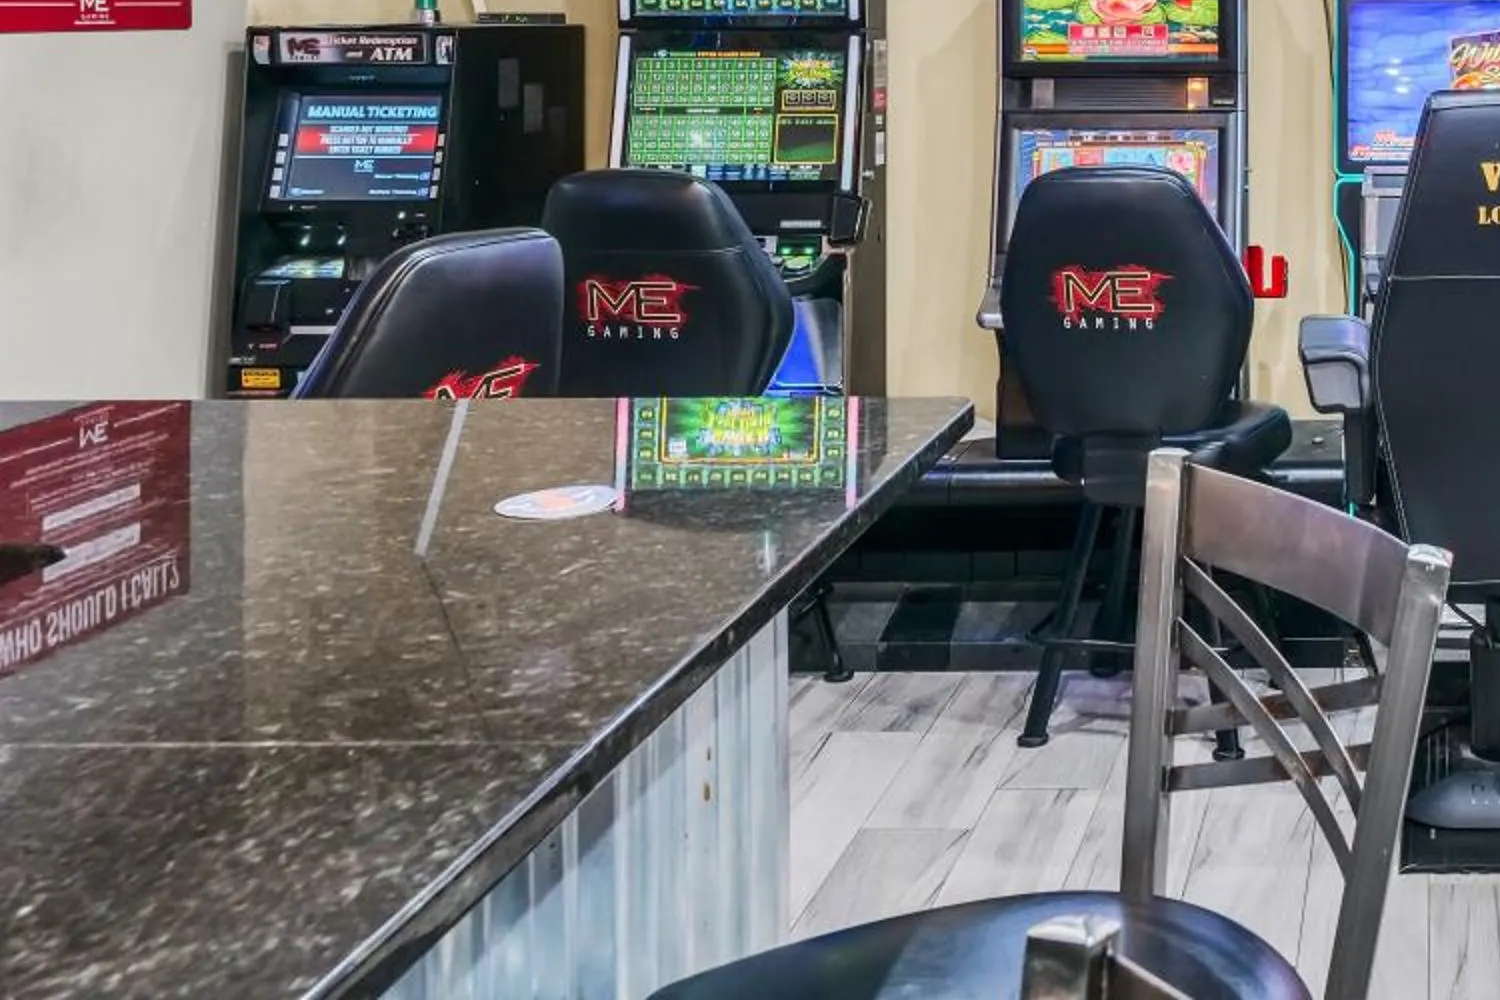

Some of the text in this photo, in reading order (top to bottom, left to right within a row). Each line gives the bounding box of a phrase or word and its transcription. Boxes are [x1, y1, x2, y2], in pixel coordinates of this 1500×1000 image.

[370, 48, 413, 61] ATM
[308, 105, 438, 118] MANUAL TICKETING
[1061, 271, 1155, 313] ME
[586, 279, 681, 323] ME
[1064, 317, 1153, 329] GAMING
[587, 326, 679, 339] GAMING
